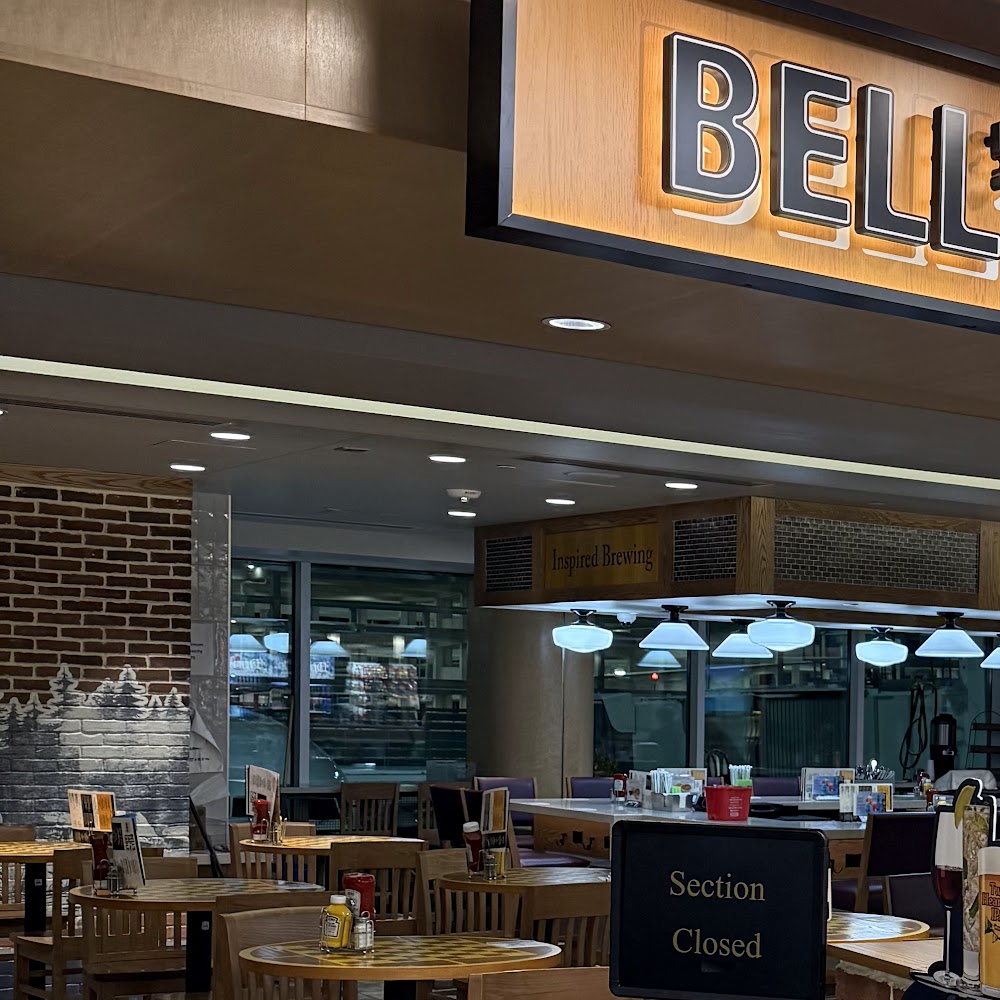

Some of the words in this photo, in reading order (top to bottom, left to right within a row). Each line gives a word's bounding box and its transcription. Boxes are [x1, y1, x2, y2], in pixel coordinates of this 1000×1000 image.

[552, 545, 599, 577] Inspired
[602, 544, 653, 572] Brewing
[669, 870, 766, 902] Section
[672, 927, 762, 959] Closed
